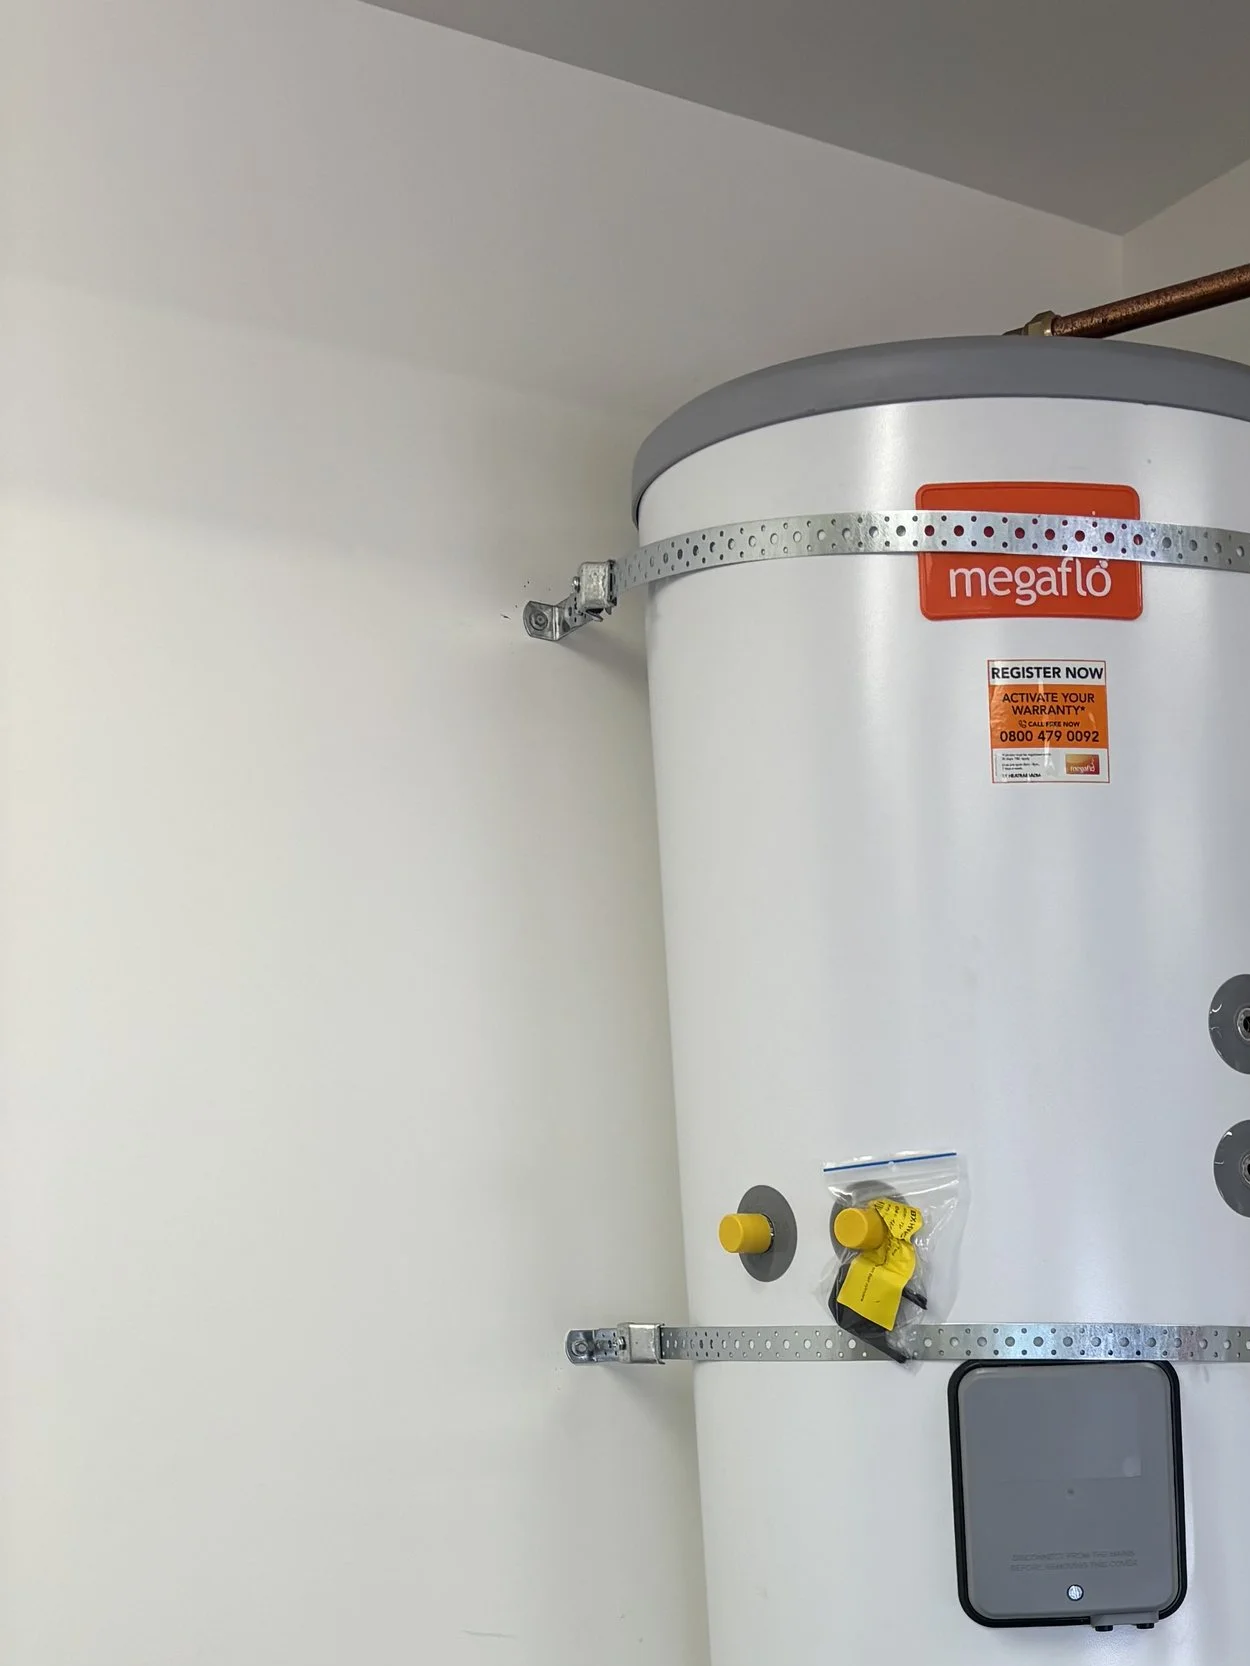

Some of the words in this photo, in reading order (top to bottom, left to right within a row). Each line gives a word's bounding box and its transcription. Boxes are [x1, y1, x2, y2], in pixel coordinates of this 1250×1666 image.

[991, 666, 1062, 679] REGISTER
[1065, 667, 1104, 680] NOW
[1002, 692, 1059, 703] ACTIVATE
[1061, 692, 1095, 703] YOUR
[999, 730, 1033, 742] 0800
[1037, 730, 1063, 742] 479
[1066, 730, 1100, 742] 0092
